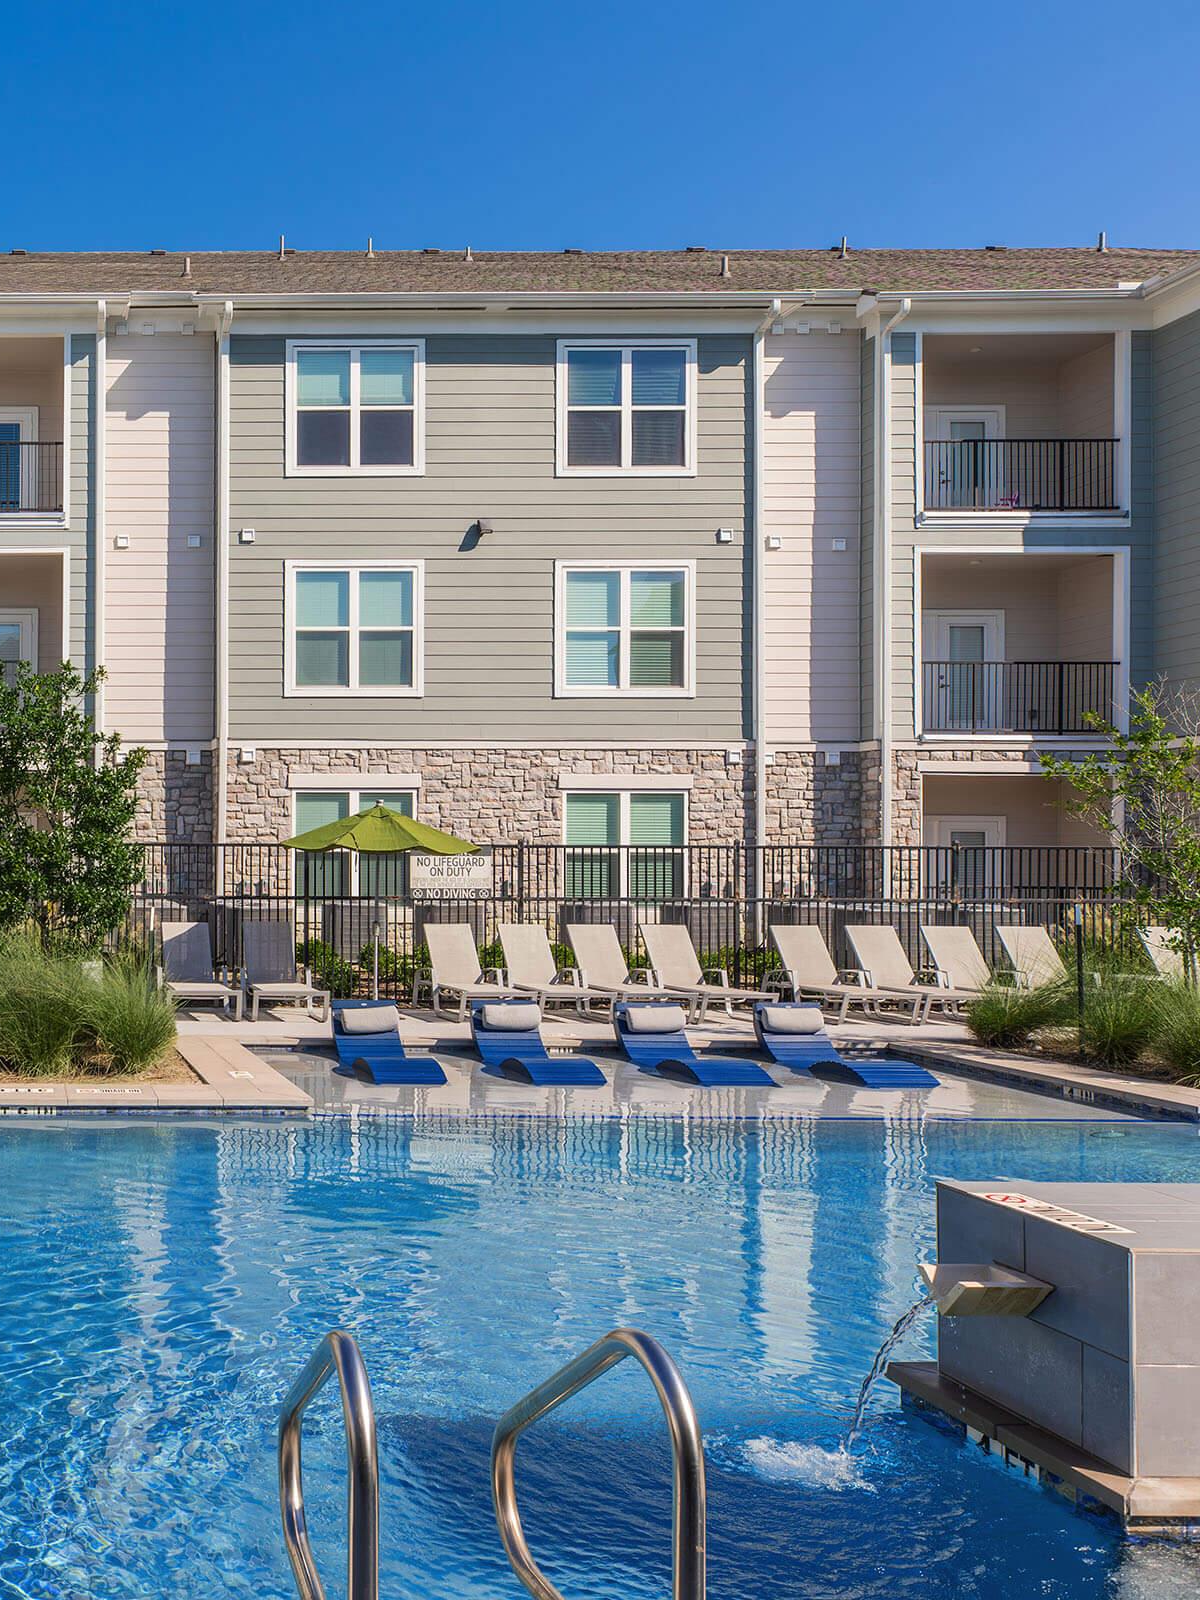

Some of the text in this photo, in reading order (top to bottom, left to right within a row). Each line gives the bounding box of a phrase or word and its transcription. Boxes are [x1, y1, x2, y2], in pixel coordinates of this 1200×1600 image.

[416, 857, 485, 867] NO LIFEGUARD
[429, 867, 472, 877] ON DUTY
[426, 888, 476, 899] NO DIVING
